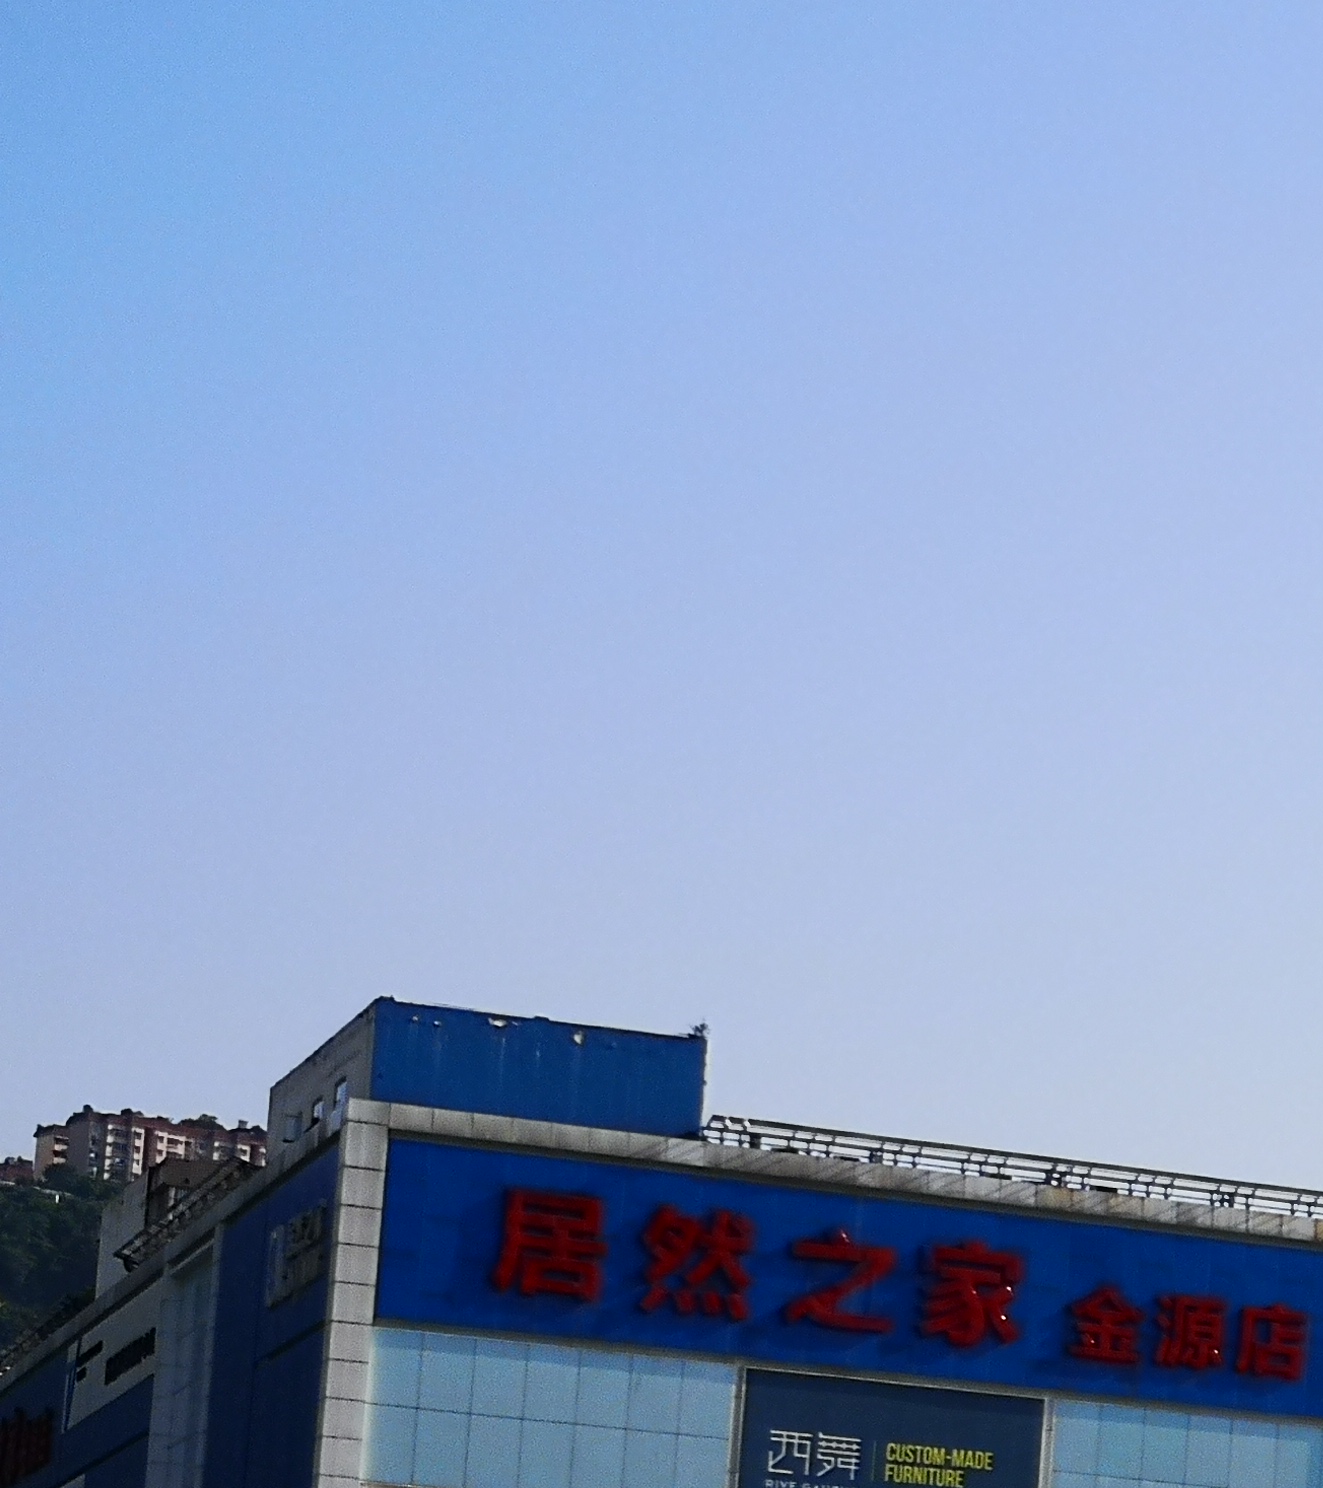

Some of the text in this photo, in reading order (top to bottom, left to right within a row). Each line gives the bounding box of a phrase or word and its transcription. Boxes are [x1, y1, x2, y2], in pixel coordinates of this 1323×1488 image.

[492, 1187, 1310, 1382] 居然之家 金源店
[885, 1441, 994, 1471] CUSTOM-MADE
[884, 1463, 965, 1488] FURNITURE
